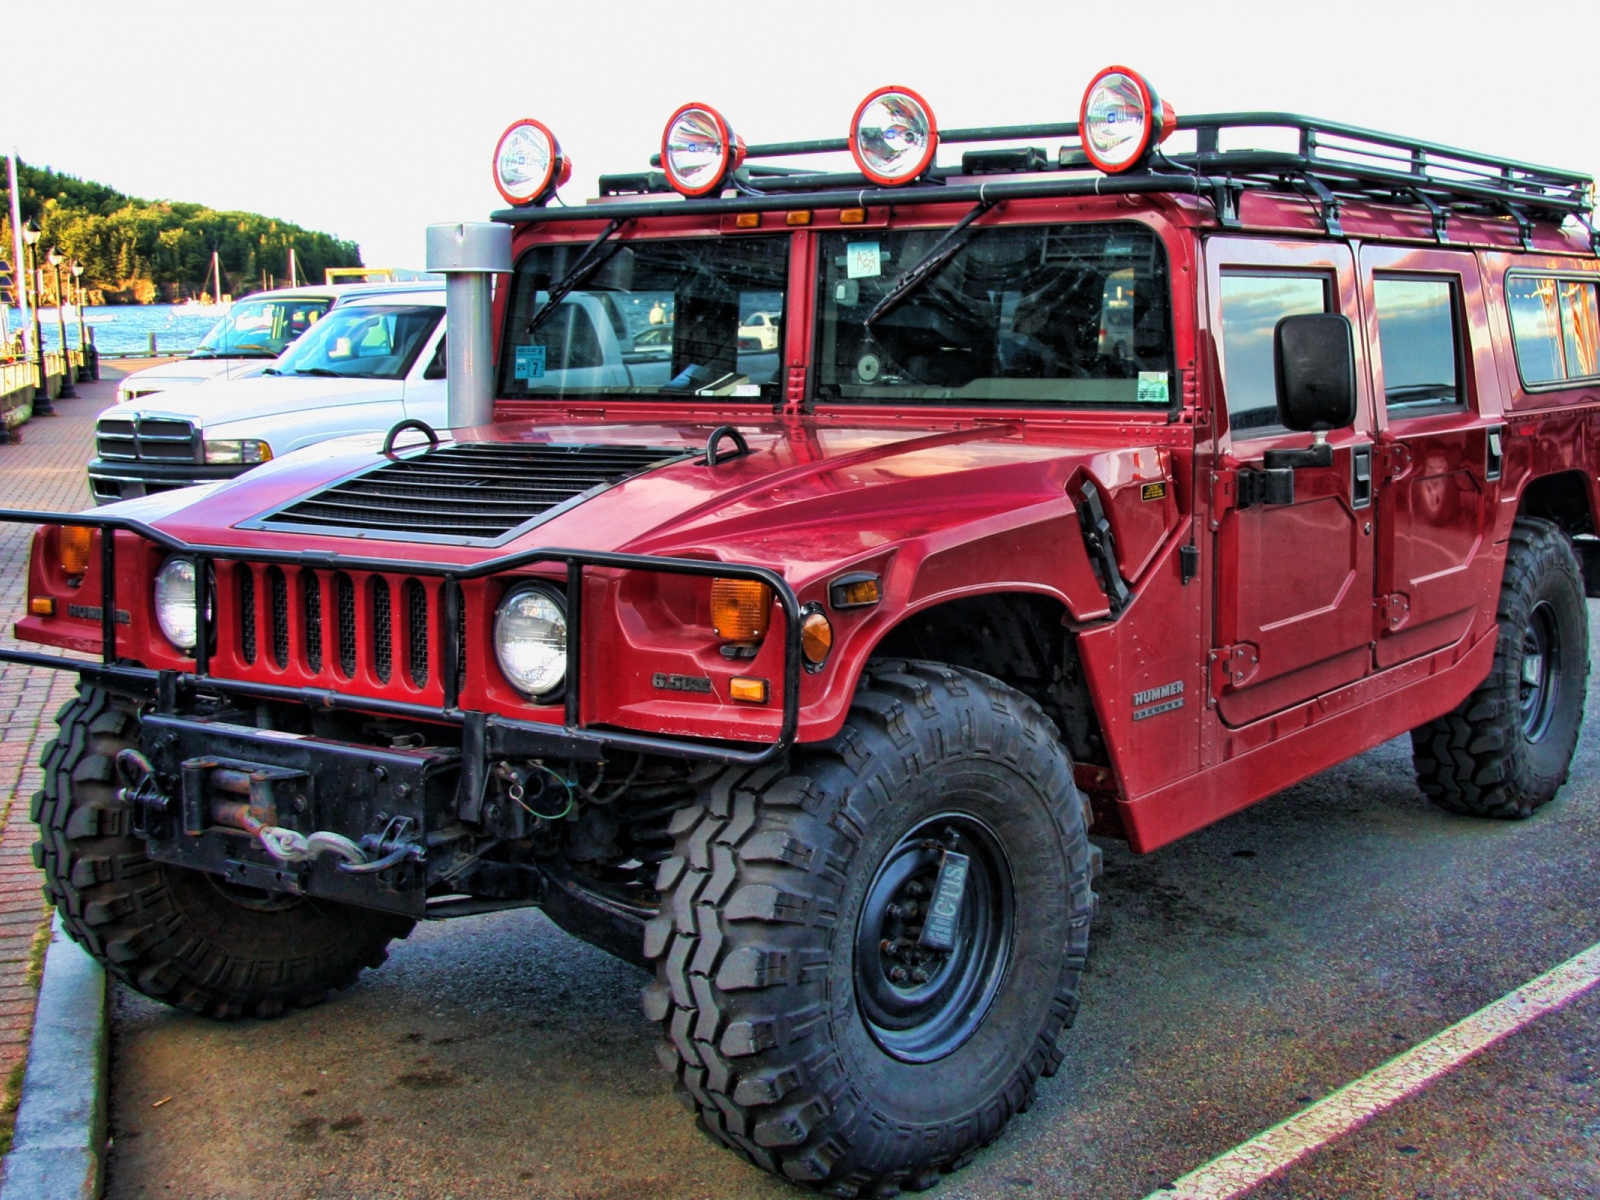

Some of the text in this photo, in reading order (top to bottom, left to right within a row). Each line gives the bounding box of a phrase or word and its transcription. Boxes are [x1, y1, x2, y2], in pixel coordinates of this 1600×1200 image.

[68, 604, 131, 625] HUMER
[1133, 681, 1185, 706] HUMMER
[934, 863, 967, 918] CTIS
